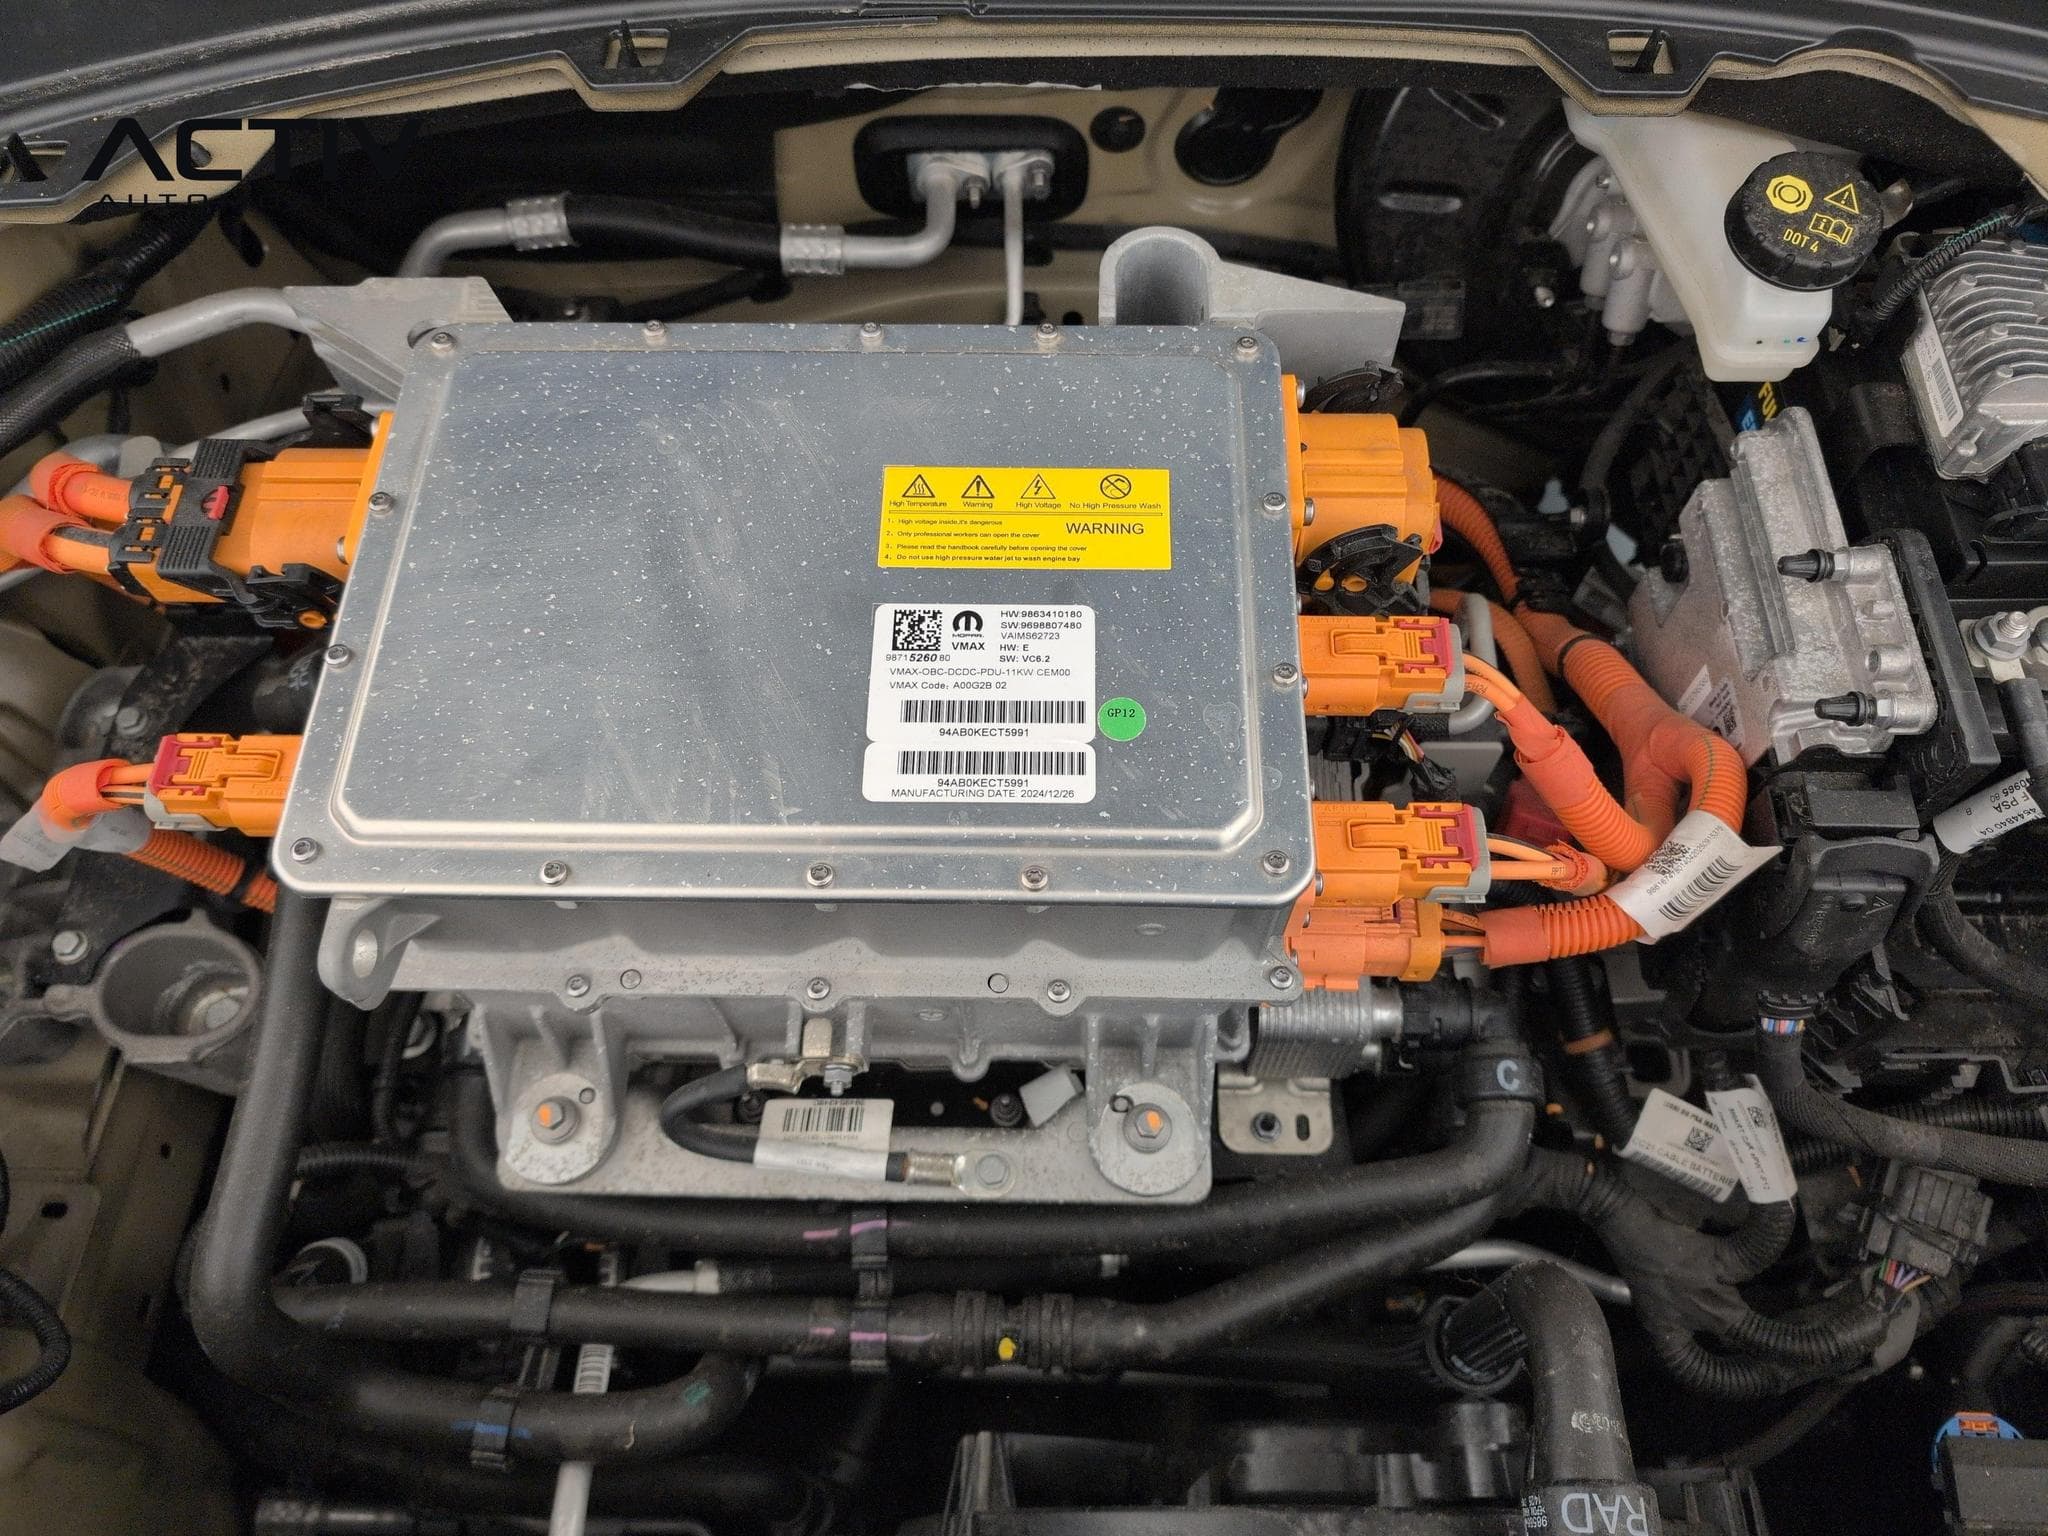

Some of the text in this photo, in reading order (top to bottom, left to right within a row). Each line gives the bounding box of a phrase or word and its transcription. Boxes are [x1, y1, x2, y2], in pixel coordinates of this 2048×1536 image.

[1784, 228, 1820, 253] DOT 4
[1066, 522, 1144, 534] WARNING
[952, 642, 985, 650] VMAX
[921, 682, 949, 690] Code:
[1107, 708, 1136, 718] GP12
[939, 728, 1029, 737] 94AB0KECT5991
[937, 778, 1029, 788] 94AB0KECT5991
[891, 789, 1075, 798] MANUFACTURING DATE 2024/12/26
[1992, 797, 2019, 813] PSA
[1496, 1059, 1520, 1091] C
[1561, 1493, 1648, 1536] RAD
